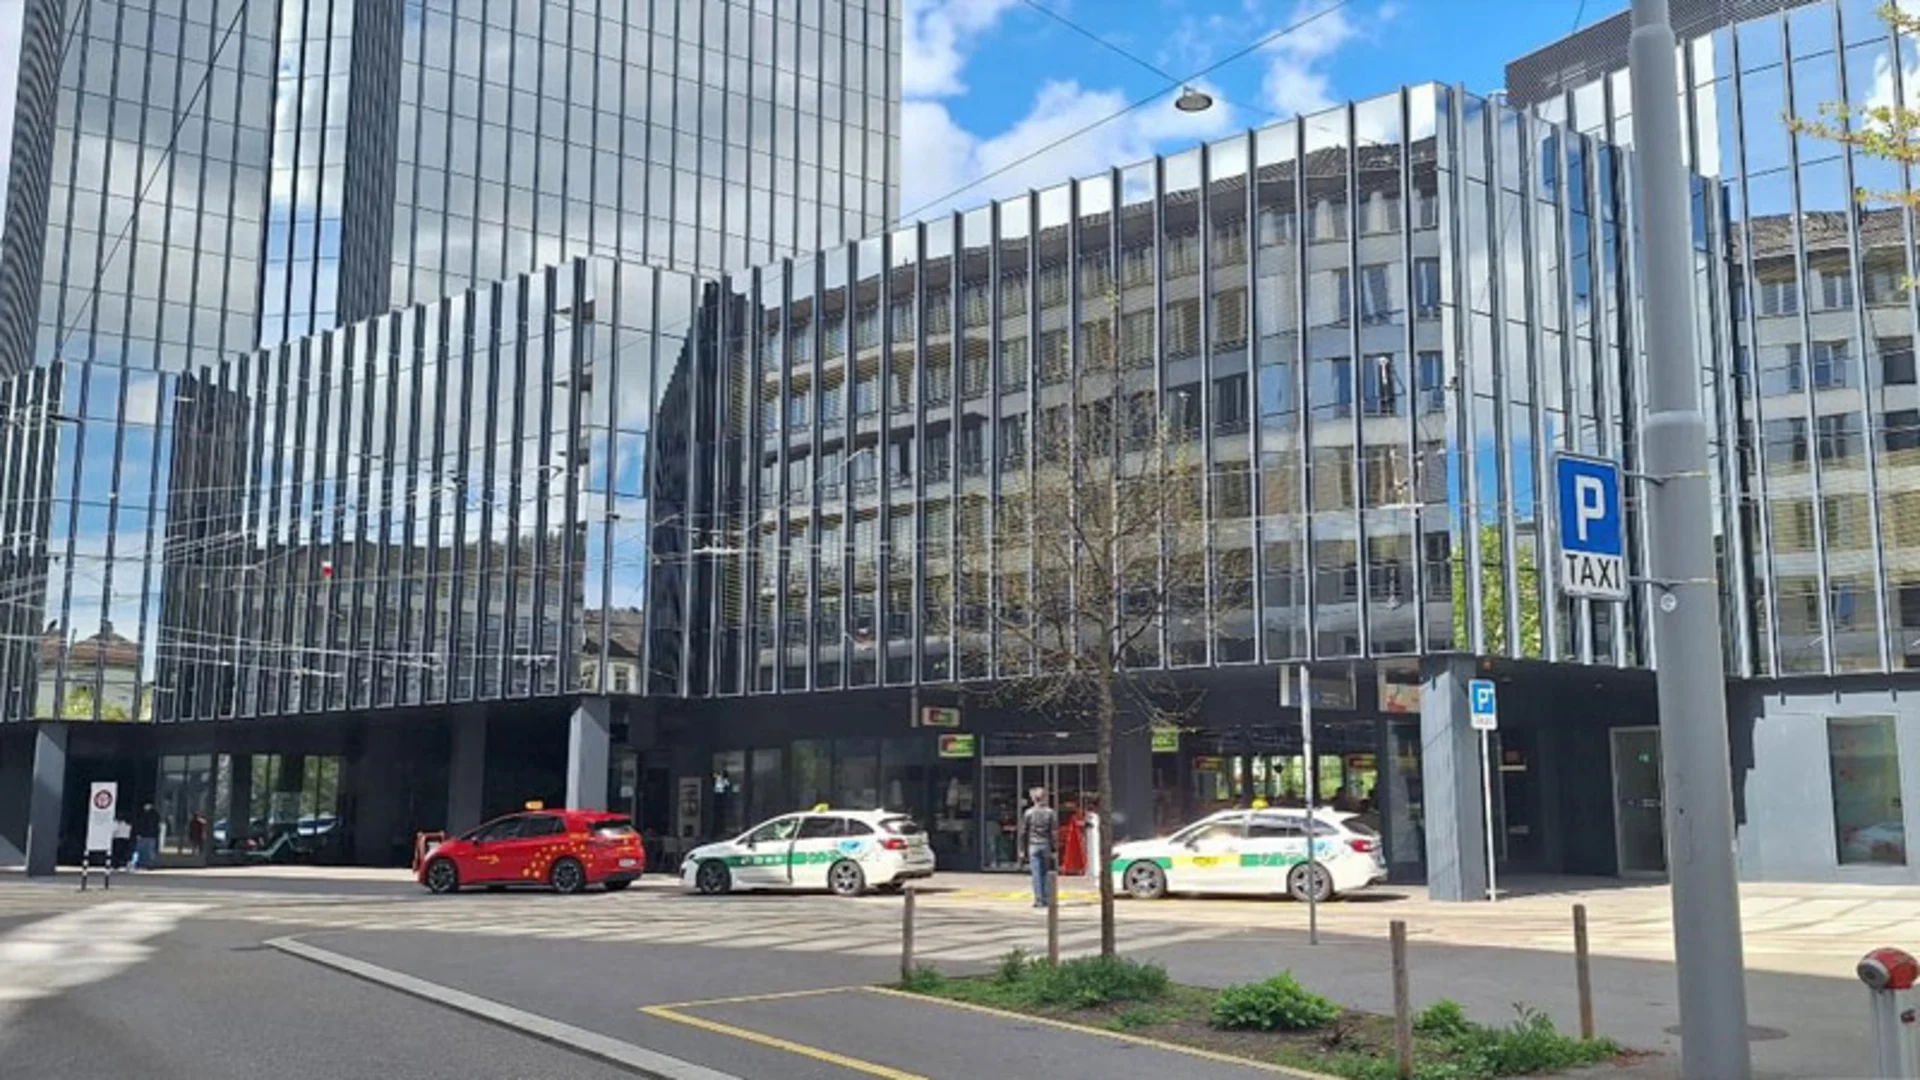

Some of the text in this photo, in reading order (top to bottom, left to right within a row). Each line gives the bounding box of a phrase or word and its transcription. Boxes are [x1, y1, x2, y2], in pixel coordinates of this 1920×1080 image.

[1575, 474, 1605, 541] P
[1566, 554, 1620, 589] TAXI
[1478, 688, 1489, 711] P
